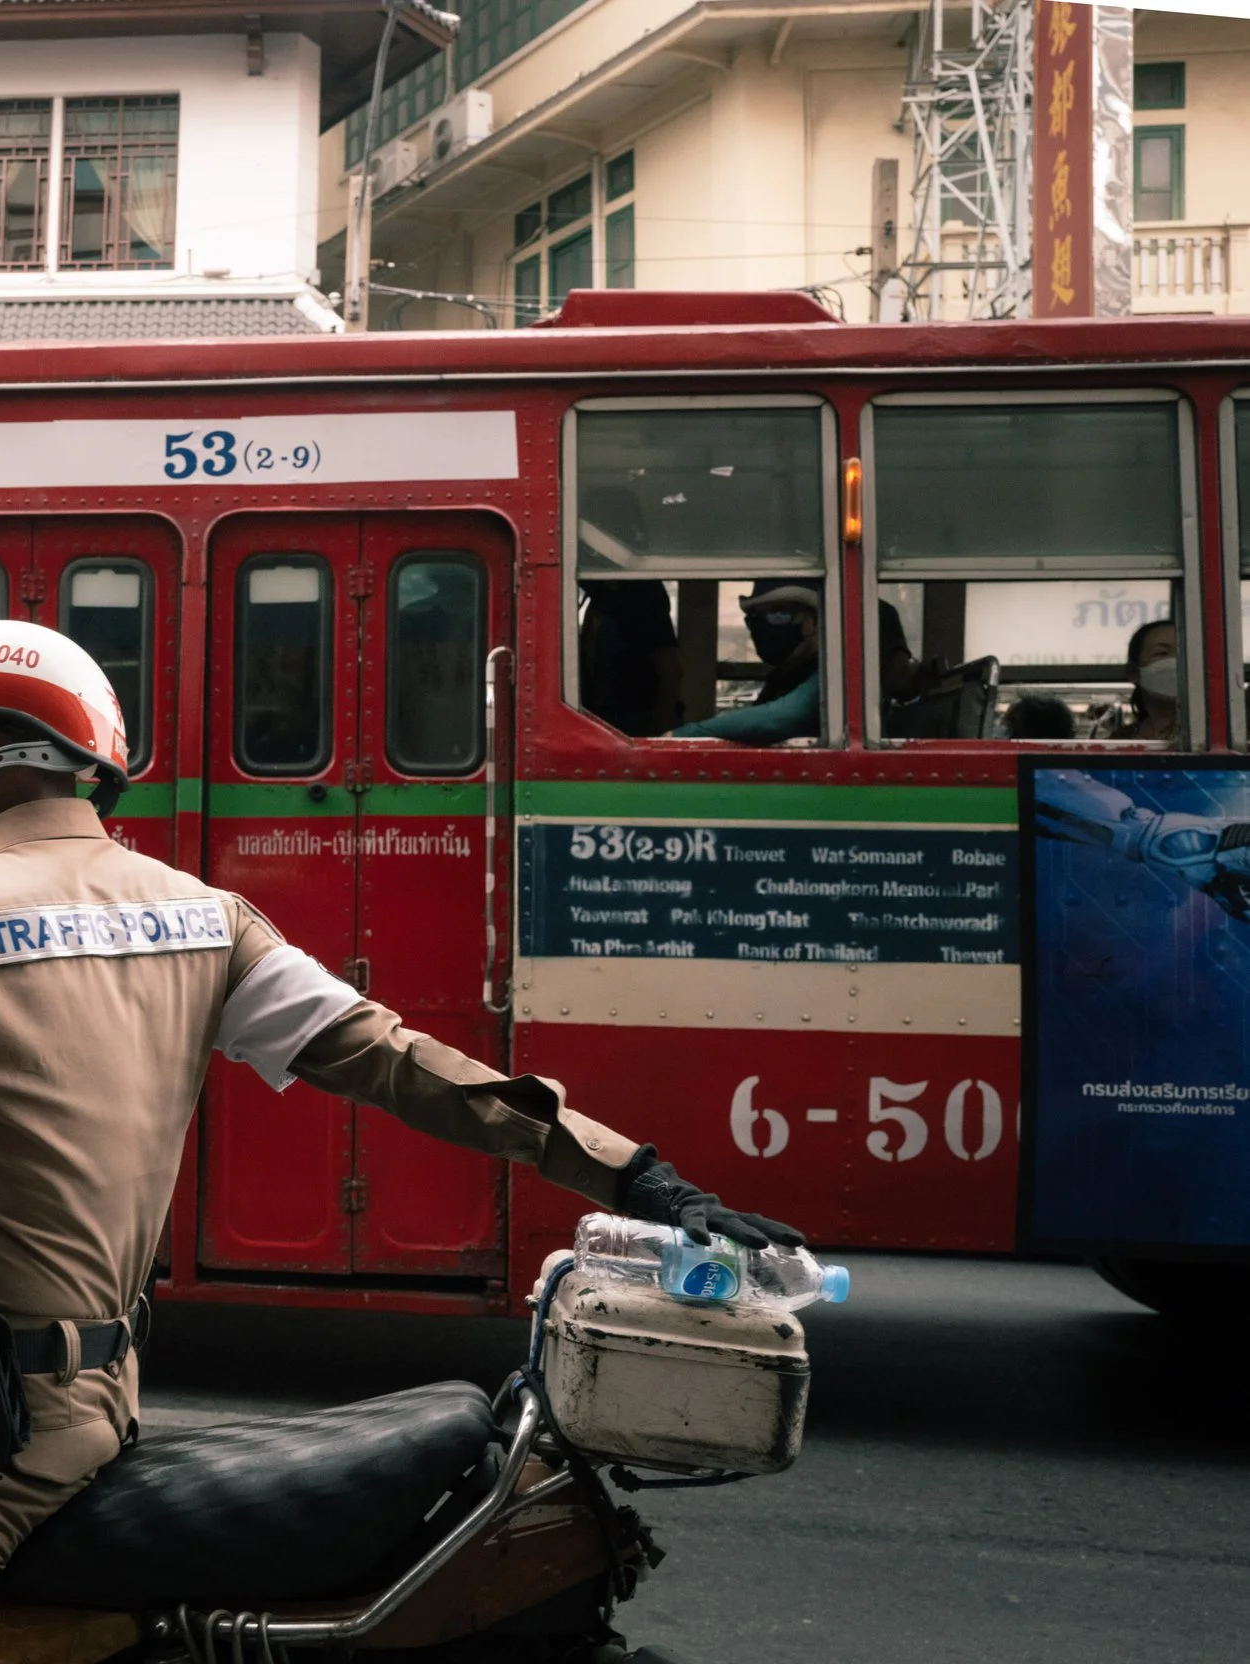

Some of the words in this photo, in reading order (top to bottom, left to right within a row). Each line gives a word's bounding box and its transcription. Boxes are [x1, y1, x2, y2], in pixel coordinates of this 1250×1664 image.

[811, 847, 844, 864] Wat
[848, 848, 924, 866] Somanat
[952, 848, 1006, 866] Bobae
[121, 907, 223, 943] POLICE
